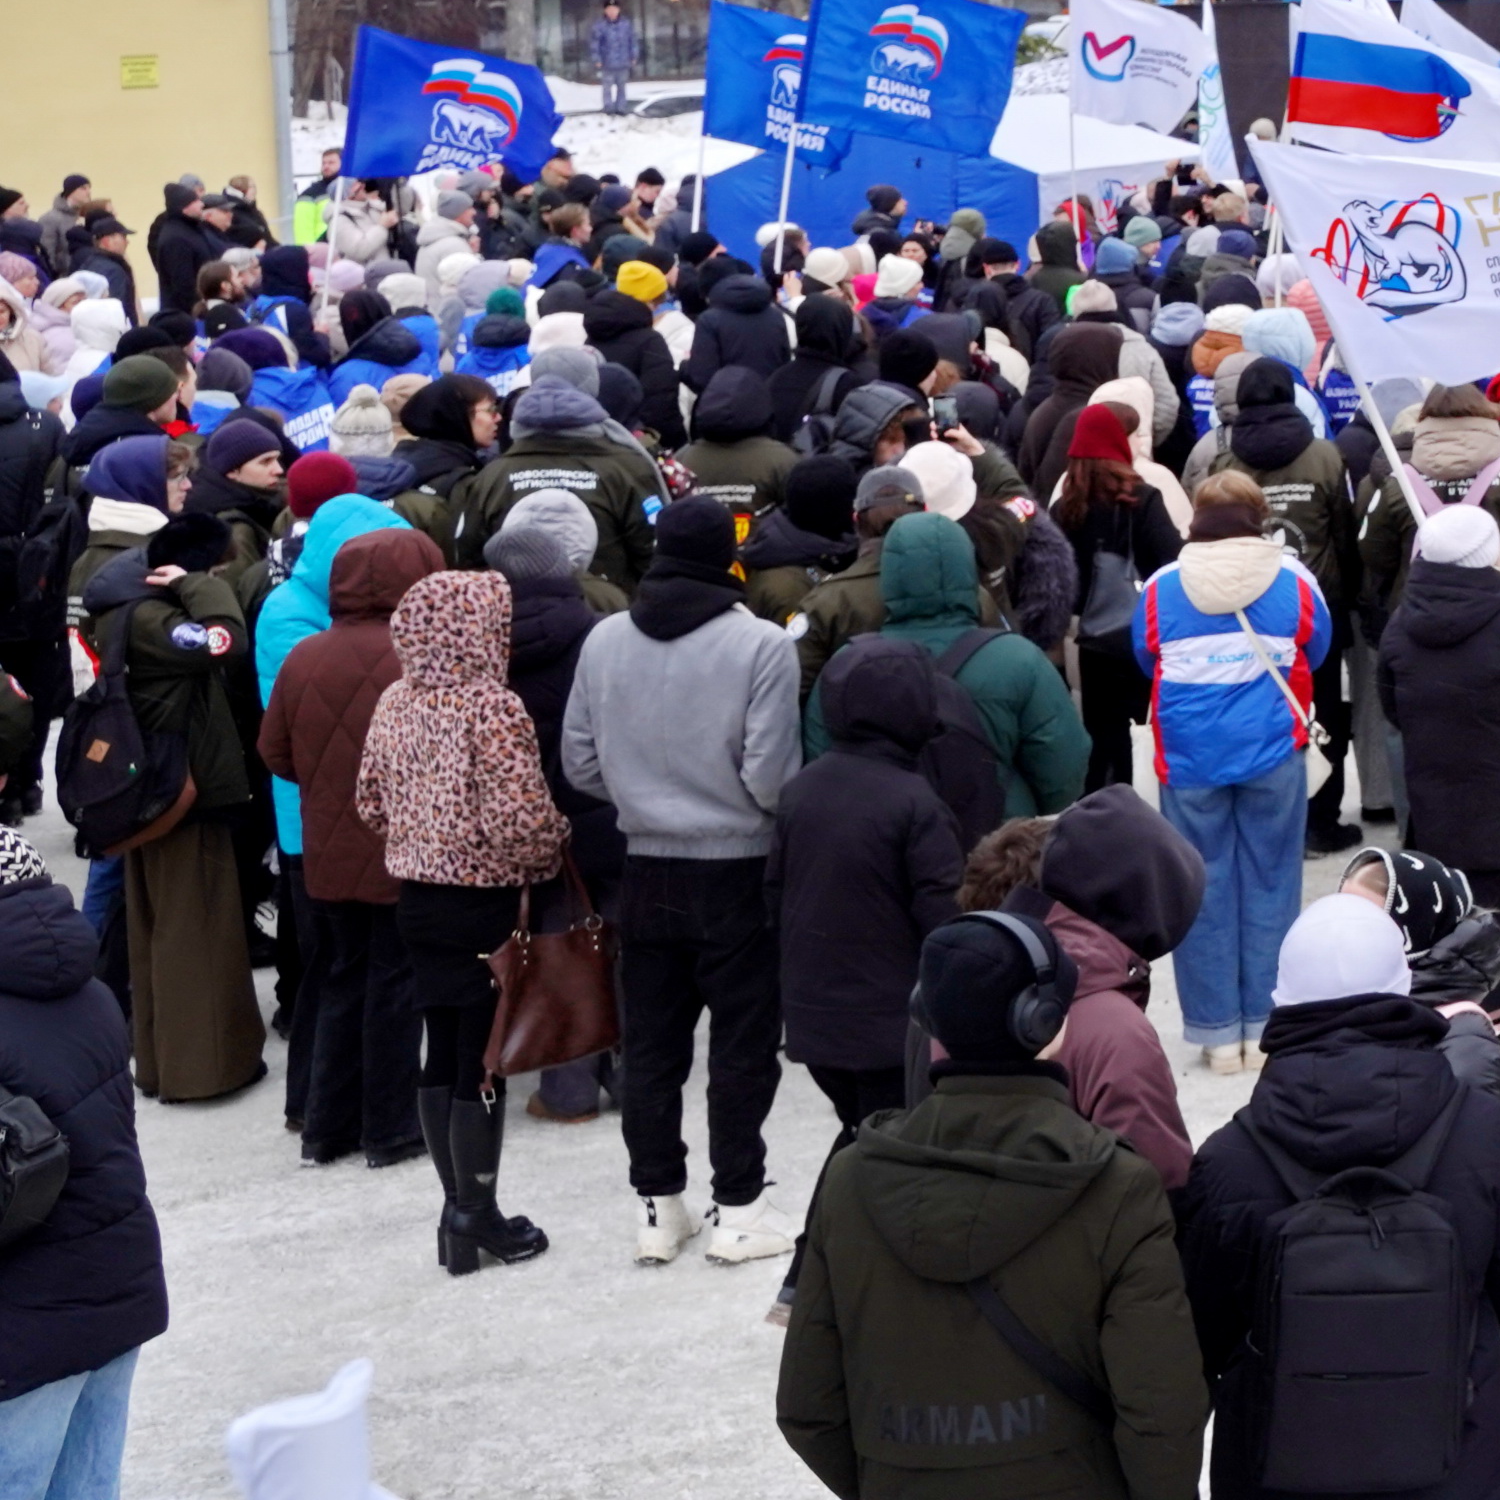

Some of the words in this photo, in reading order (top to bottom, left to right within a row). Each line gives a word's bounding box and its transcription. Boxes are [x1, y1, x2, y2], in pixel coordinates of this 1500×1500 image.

[866, 75, 931, 103] ЕДИНАЯ
[863, 92, 932, 120] РОССИЯ
[765, 120, 826, 152] РОСИЯ
